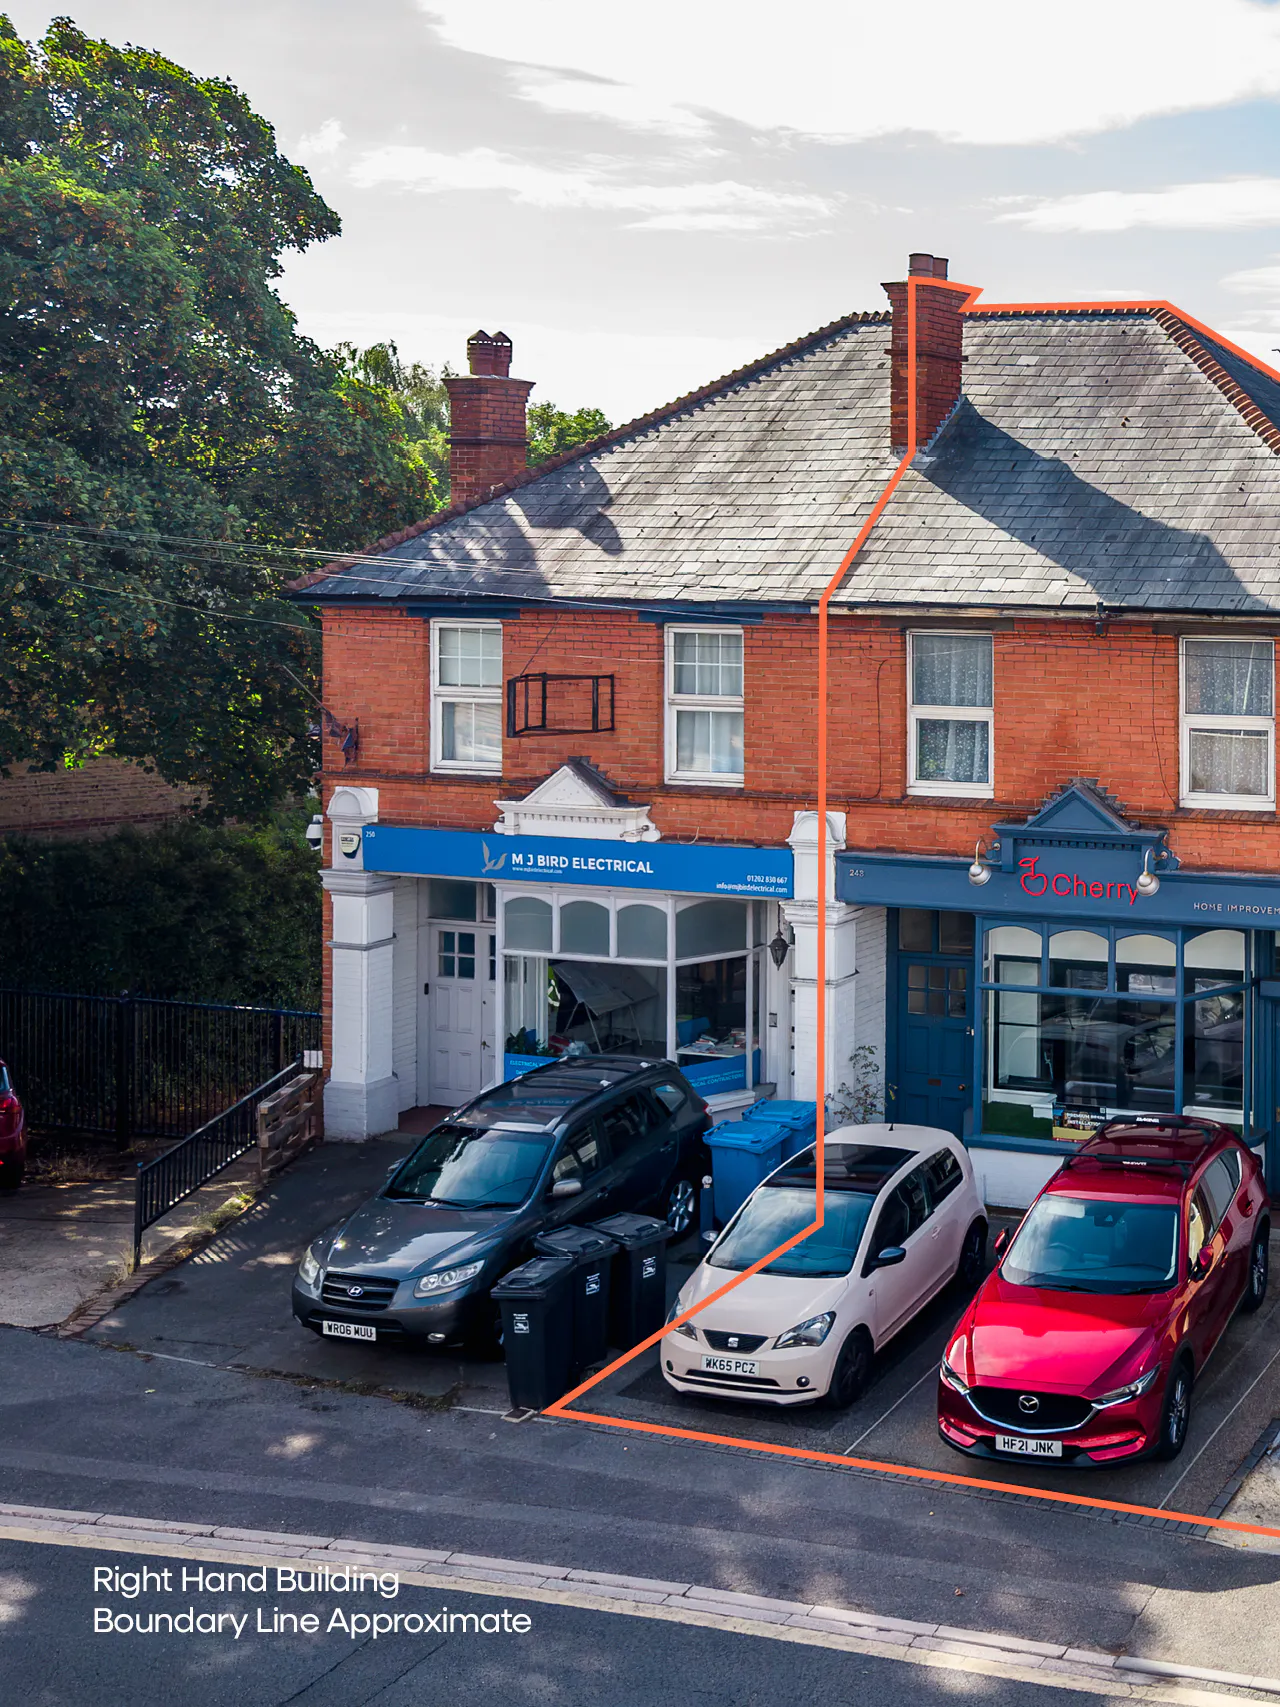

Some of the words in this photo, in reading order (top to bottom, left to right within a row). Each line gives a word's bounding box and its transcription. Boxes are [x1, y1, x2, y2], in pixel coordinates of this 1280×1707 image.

[365, 830, 376, 838] 250
[511, 853, 524, 865] M
[526, 854, 534, 867] J
[537, 855, 569, 869] BIRD
[572, 857, 655, 874] ELECTRICAL
[746, 874, 764, 883] 01202
[765, 876, 776, 884] 830
[777, 876, 788, 884] 667
[716, 881, 788, 894] info@mjbirdelectrical.com
[1051, 873, 1139, 905] Cherry
[1193, 902, 1223, 912] HOME
[327, 1322, 351, 1336] WR06
[353, 1326, 374, 1338] MUU
[705, 1357, 732, 1372] WK65
[735, 1361, 756, 1375] PCZ
[1003, 1437, 1028, 1452] HF21
[1031, 1441, 1055, 1454] JNK
